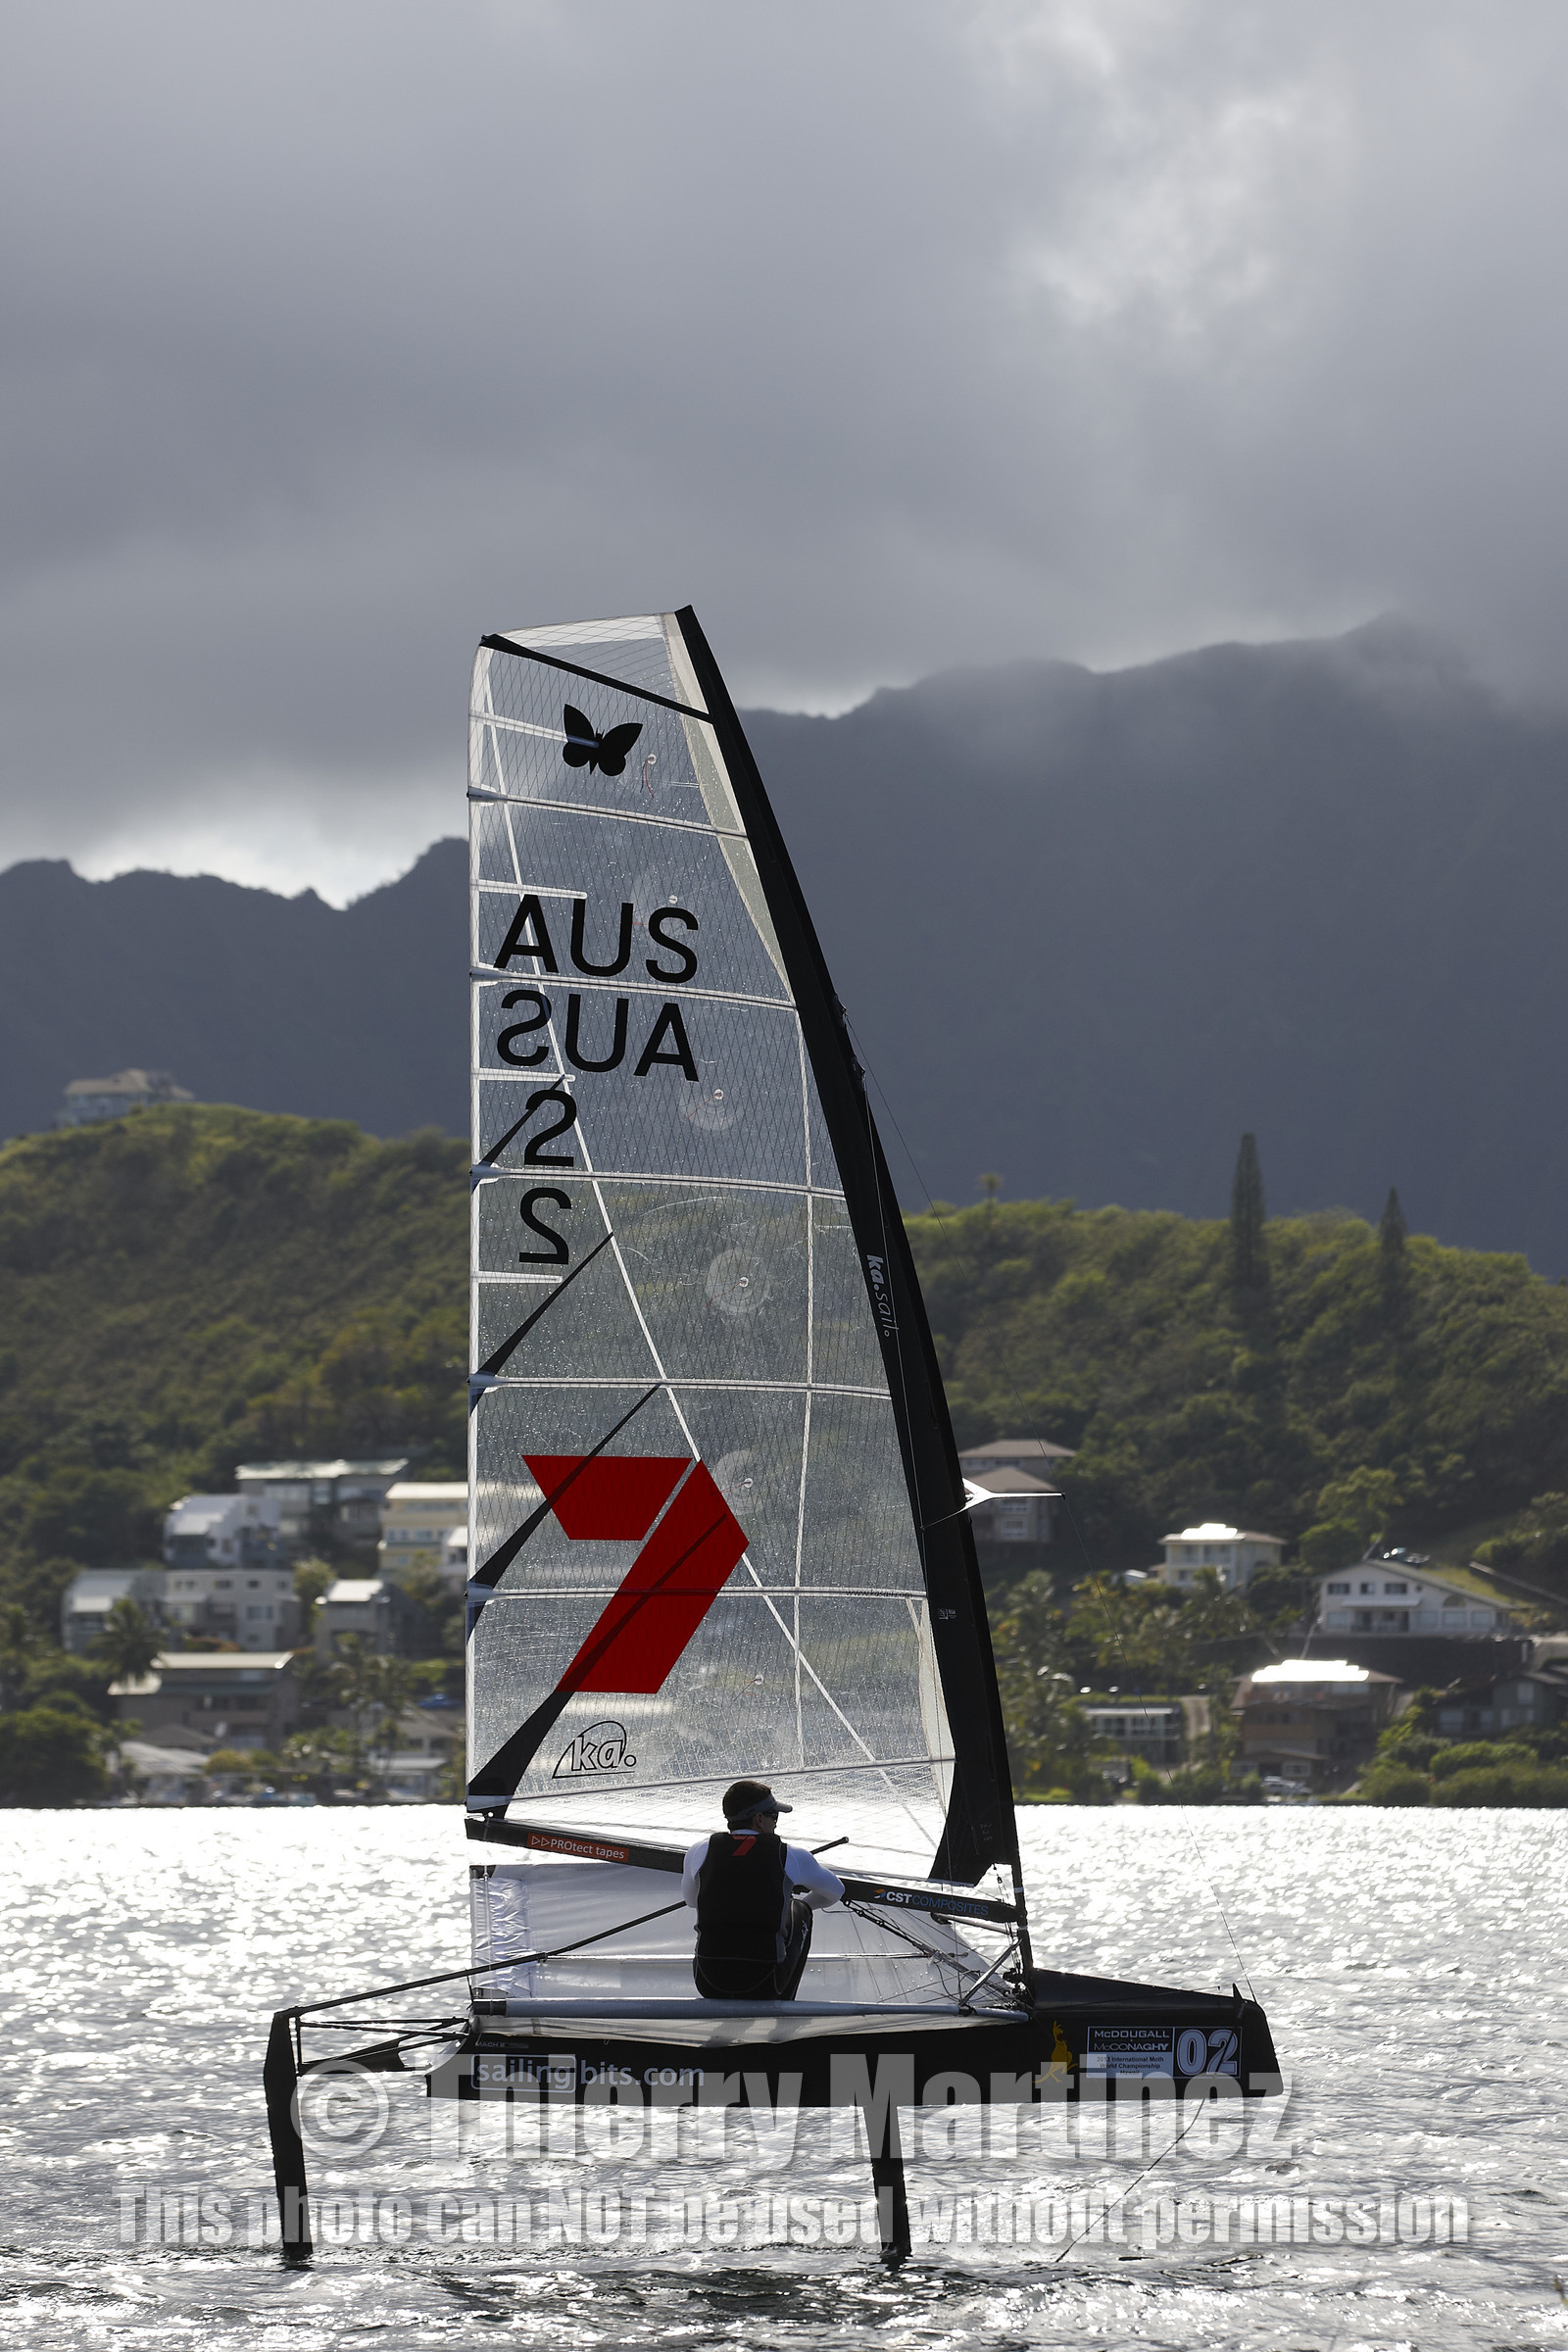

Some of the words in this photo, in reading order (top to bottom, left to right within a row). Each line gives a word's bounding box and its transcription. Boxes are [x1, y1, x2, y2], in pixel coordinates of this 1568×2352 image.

[494, 894, 699, 983] AUS
[523, 1090, 577, 1167] 2
[521, 1454, 750, 1694] 7
[550, 1838, 594, 1854] PROtect
[596, 1847, 625, 1859] tapes
[1094, 2030, 1170, 2038] McDOUGALL
[1094, 2042, 1169, 2051] McCONAGHY
[1176, 2029, 1239, 2076] 02
